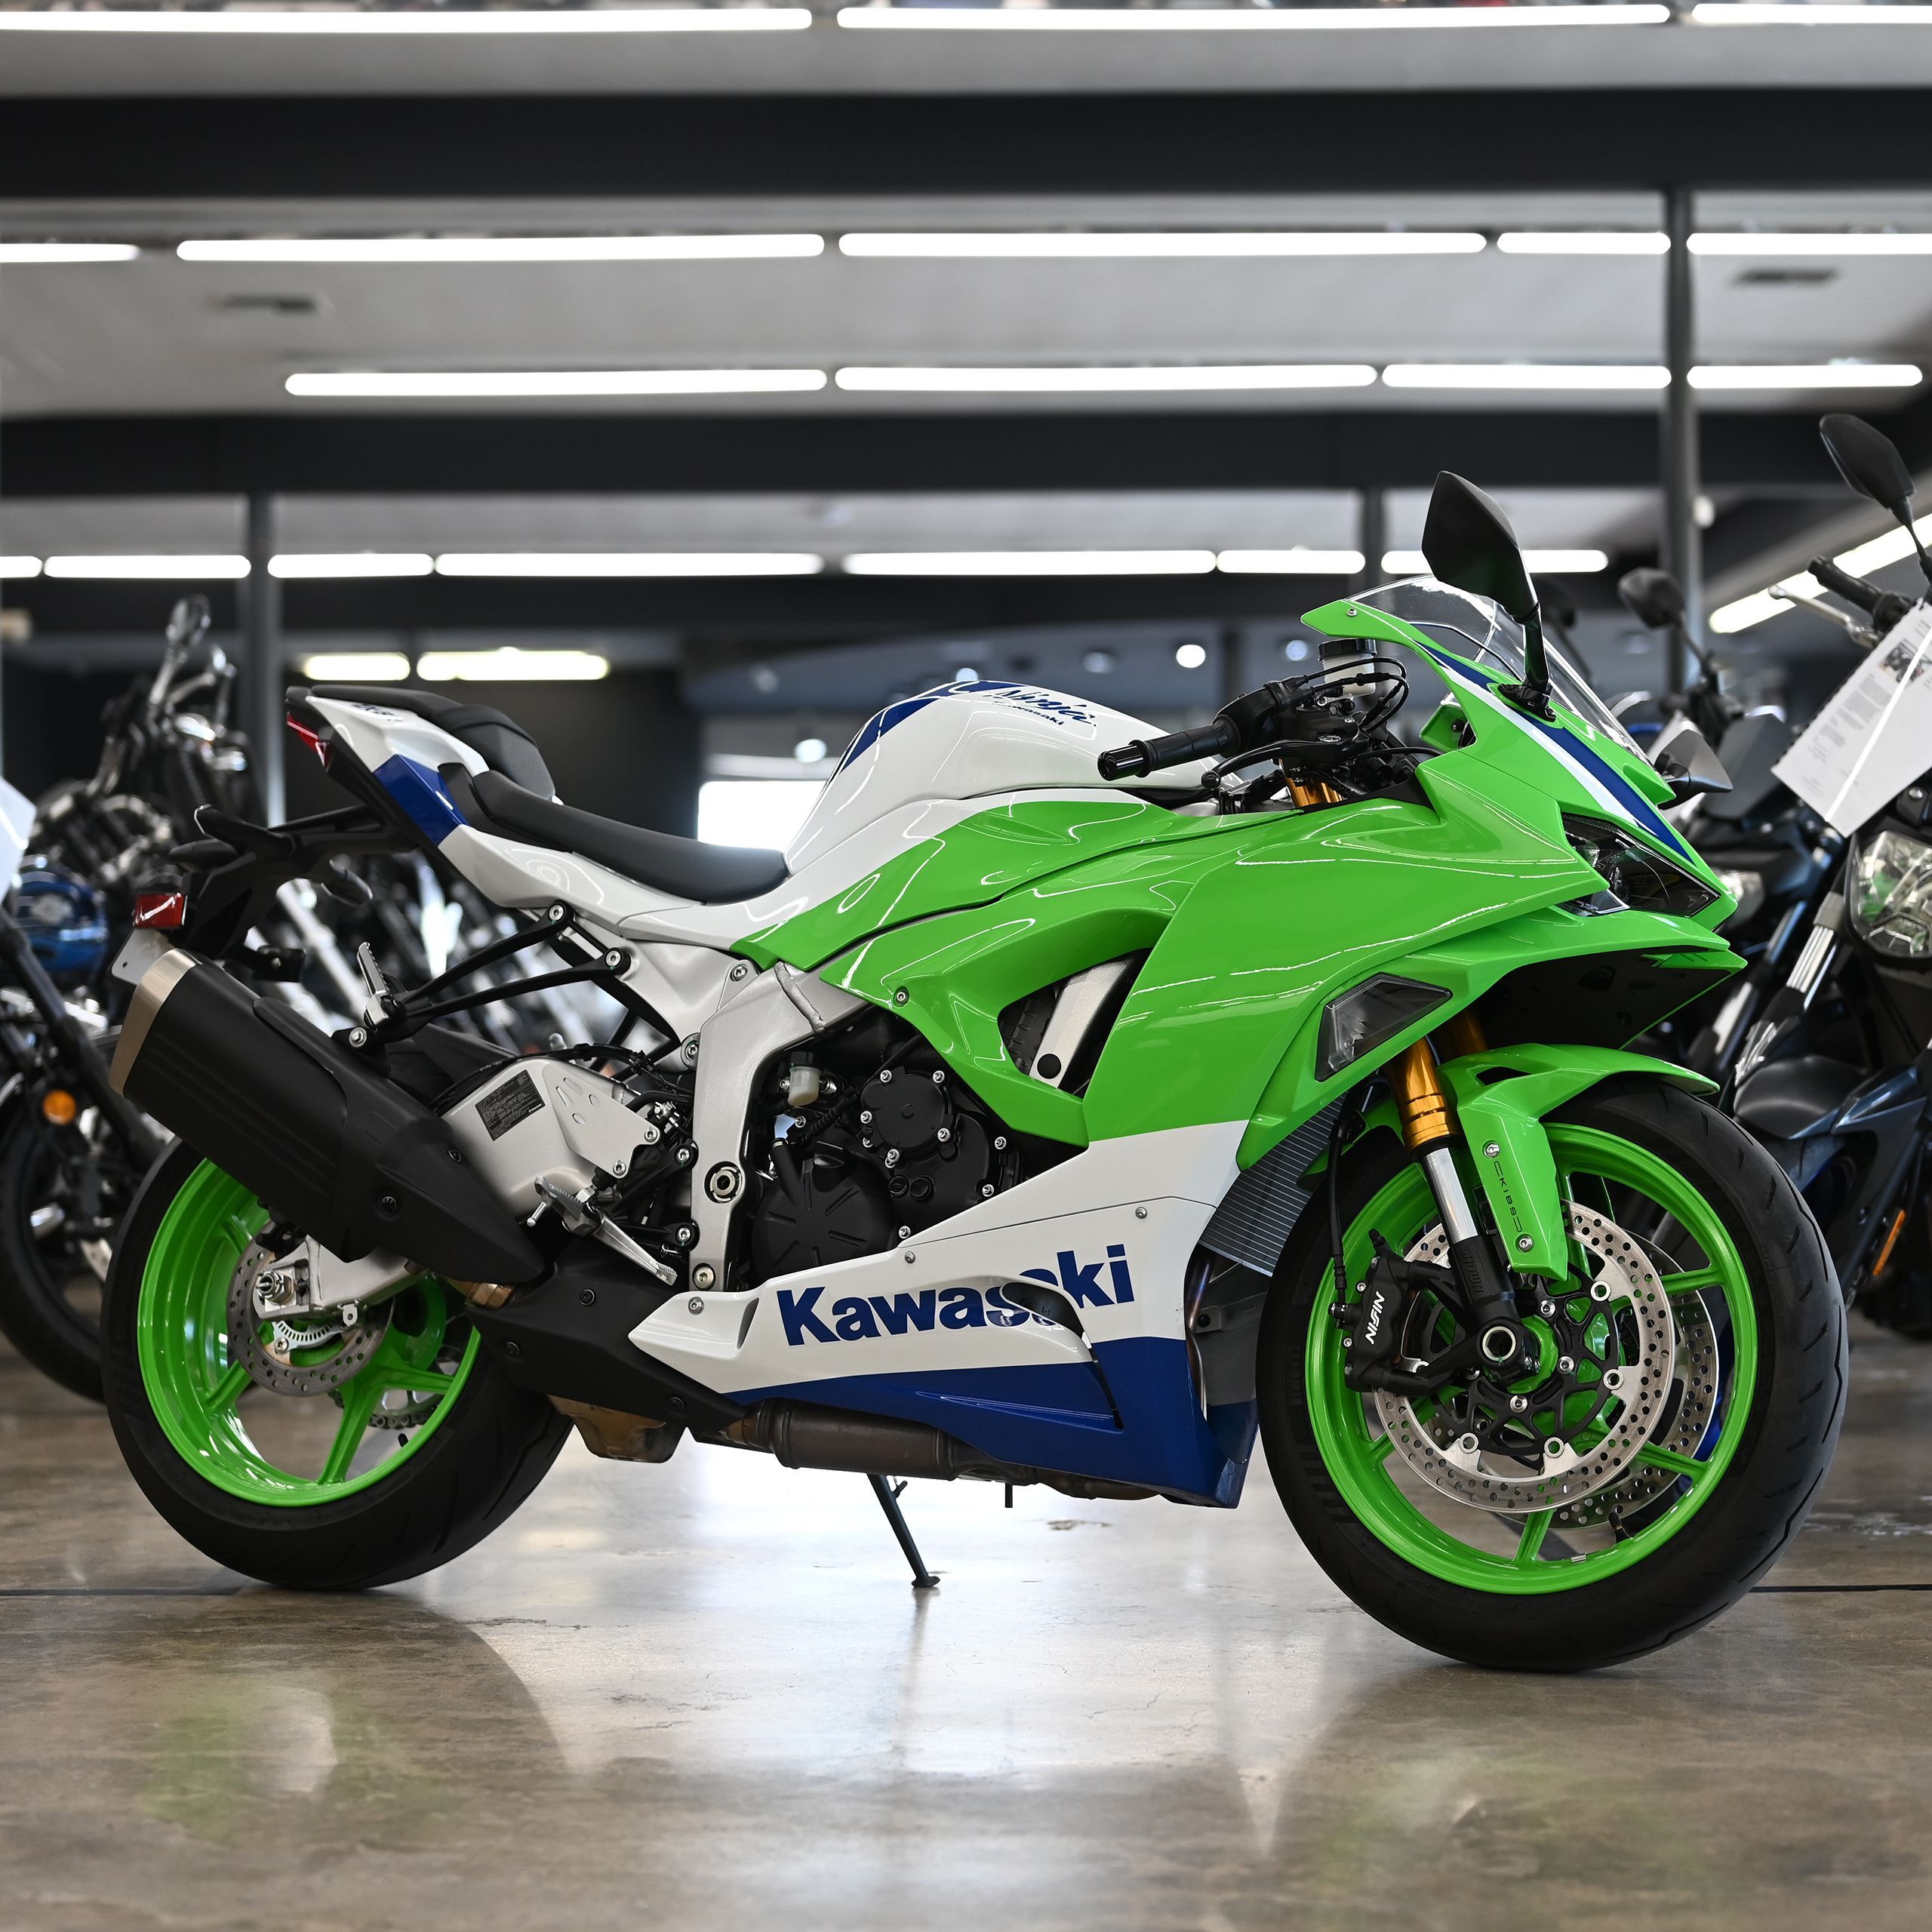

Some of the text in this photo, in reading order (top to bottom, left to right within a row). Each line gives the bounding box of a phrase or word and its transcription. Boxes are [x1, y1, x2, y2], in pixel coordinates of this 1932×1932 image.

[981, 689, 1097, 727] Ninja
[992, 701, 1065, 726] wasaki
[1460, 1245, 1486, 1294] SHOWA
[1365, 1291, 1385, 1345] NISSIN
